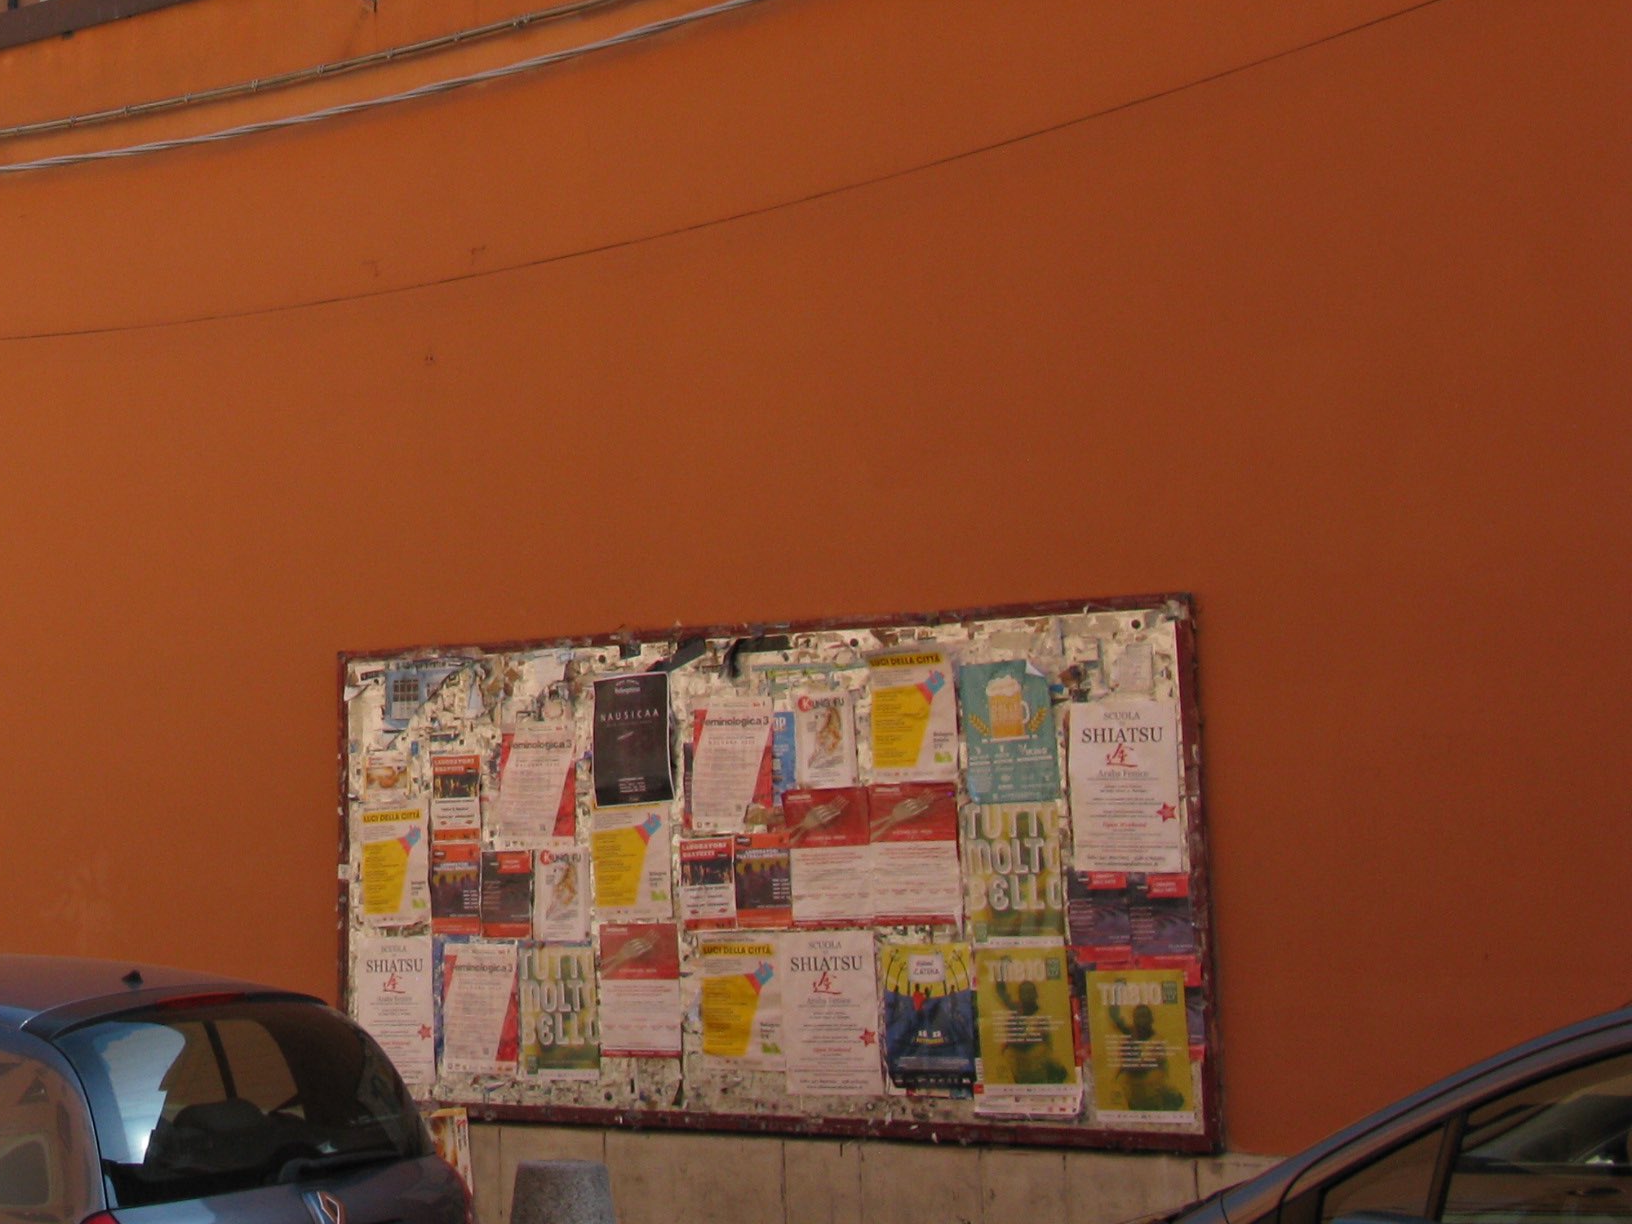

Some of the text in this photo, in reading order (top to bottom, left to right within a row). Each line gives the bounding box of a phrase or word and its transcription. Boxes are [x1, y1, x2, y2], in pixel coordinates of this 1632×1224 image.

[891, 656, 915, 665] DELLA
[600, 708, 660, 722] NAUSICAA
[1103, 711, 1141, 721] SCUOLA
[1081, 726, 1164, 744] SHIATSU
[703, 944, 721, 955] LUCI
[723, 945, 746, 955] DELLA
[808, 941, 842, 950] SCUOLA
[366, 958, 424, 973] SHIATSU
[790, 955, 863, 972] SHIATSU
